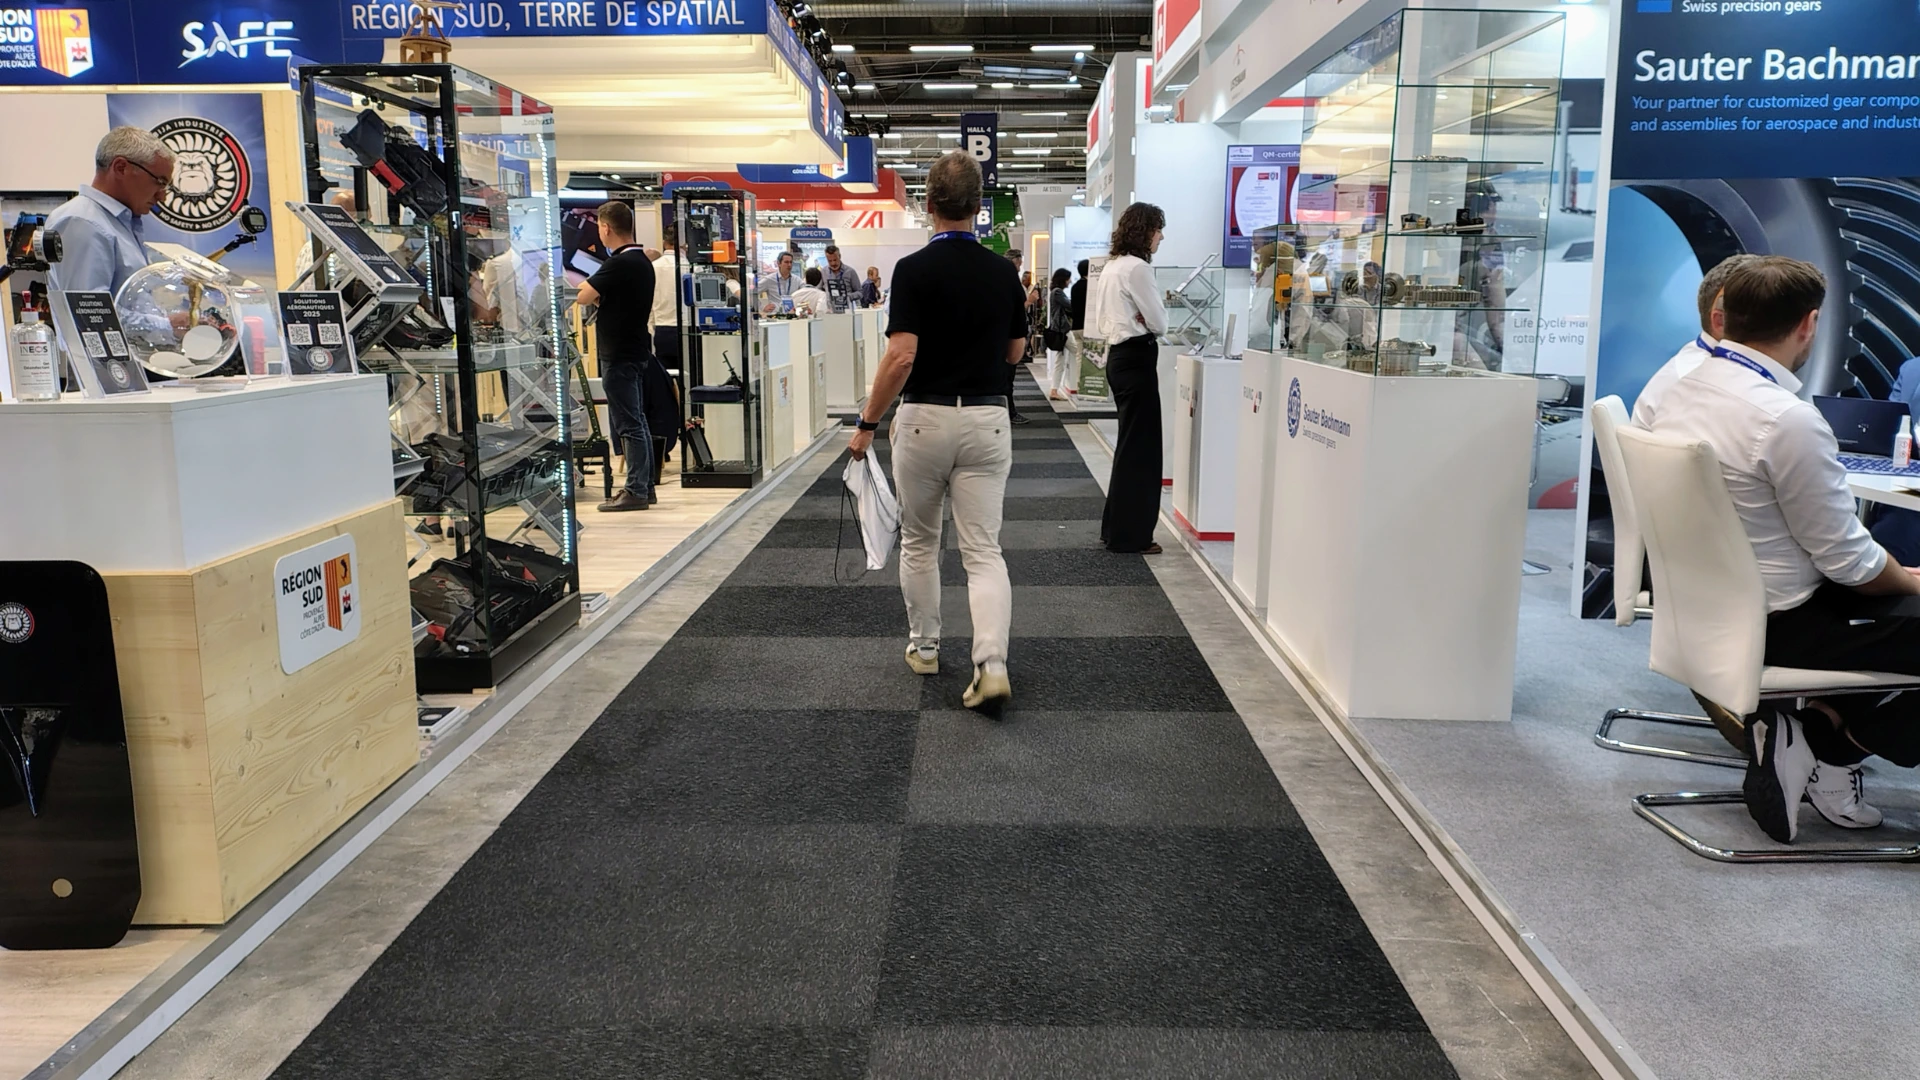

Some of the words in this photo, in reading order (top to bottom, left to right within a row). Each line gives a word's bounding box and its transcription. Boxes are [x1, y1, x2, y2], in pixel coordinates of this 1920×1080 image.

[1682, 0, 1718, 13] Swiss
[1721, 0, 1781, 15] precision
[1785, 1, 1822, 14] gears
[352, 0, 444, 29] RÉGION
[454, 3, 511, 31] SUD,
[519, 1, 597, 28] TERRE
[606, 1, 637, 26] DE
[646, 0, 745, 27] SPATIAL
[1634, 49, 1752, 82] Sauter
[1632, 96, 1663, 109] Your
[1668, 95, 1718, 111] partner
[1723, 94, 1744, 109] for
[1748, 94, 1828, 109] customized
[1833, 96, 1865, 110] gear
[174, 120, 226, 138] INDUSTRIE
[1630, 117, 1657, 132] and
[1661, 116, 1737, 132] assemblies
[1741, 116, 1761, 131] for
[1766, 117, 1838, 132] aerospace
[1842, 116, 1869, 130] and
[967, 135, 992, 162] B
[160, 212, 170, 221] NO
[170, 216, 194, 229] SAFETY
[213, 212, 233, 226] FLIGHT
[976, 210, 991, 225] B
[797, 242, 827, 250] inspecto
[88, 315, 103, 323] 2025
[302, 310, 321, 318] 2025
[1514, 318, 1534, 328] Life
[1537, 318, 1567, 330] Cycle
[1513, 333, 1545, 346] rotary
[1559, 333, 1585, 345] wing
[20, 345, 48, 353] INEOS
[1303, 403, 1320, 424] Sauter
[1321, 409, 1351, 437] Bachmann
[281, 564, 322, 595] RÉGION
[302, 585, 323, 608] SUD
[303, 605, 325, 620] PROVENCE
[312, 614, 325, 625] ALPES
